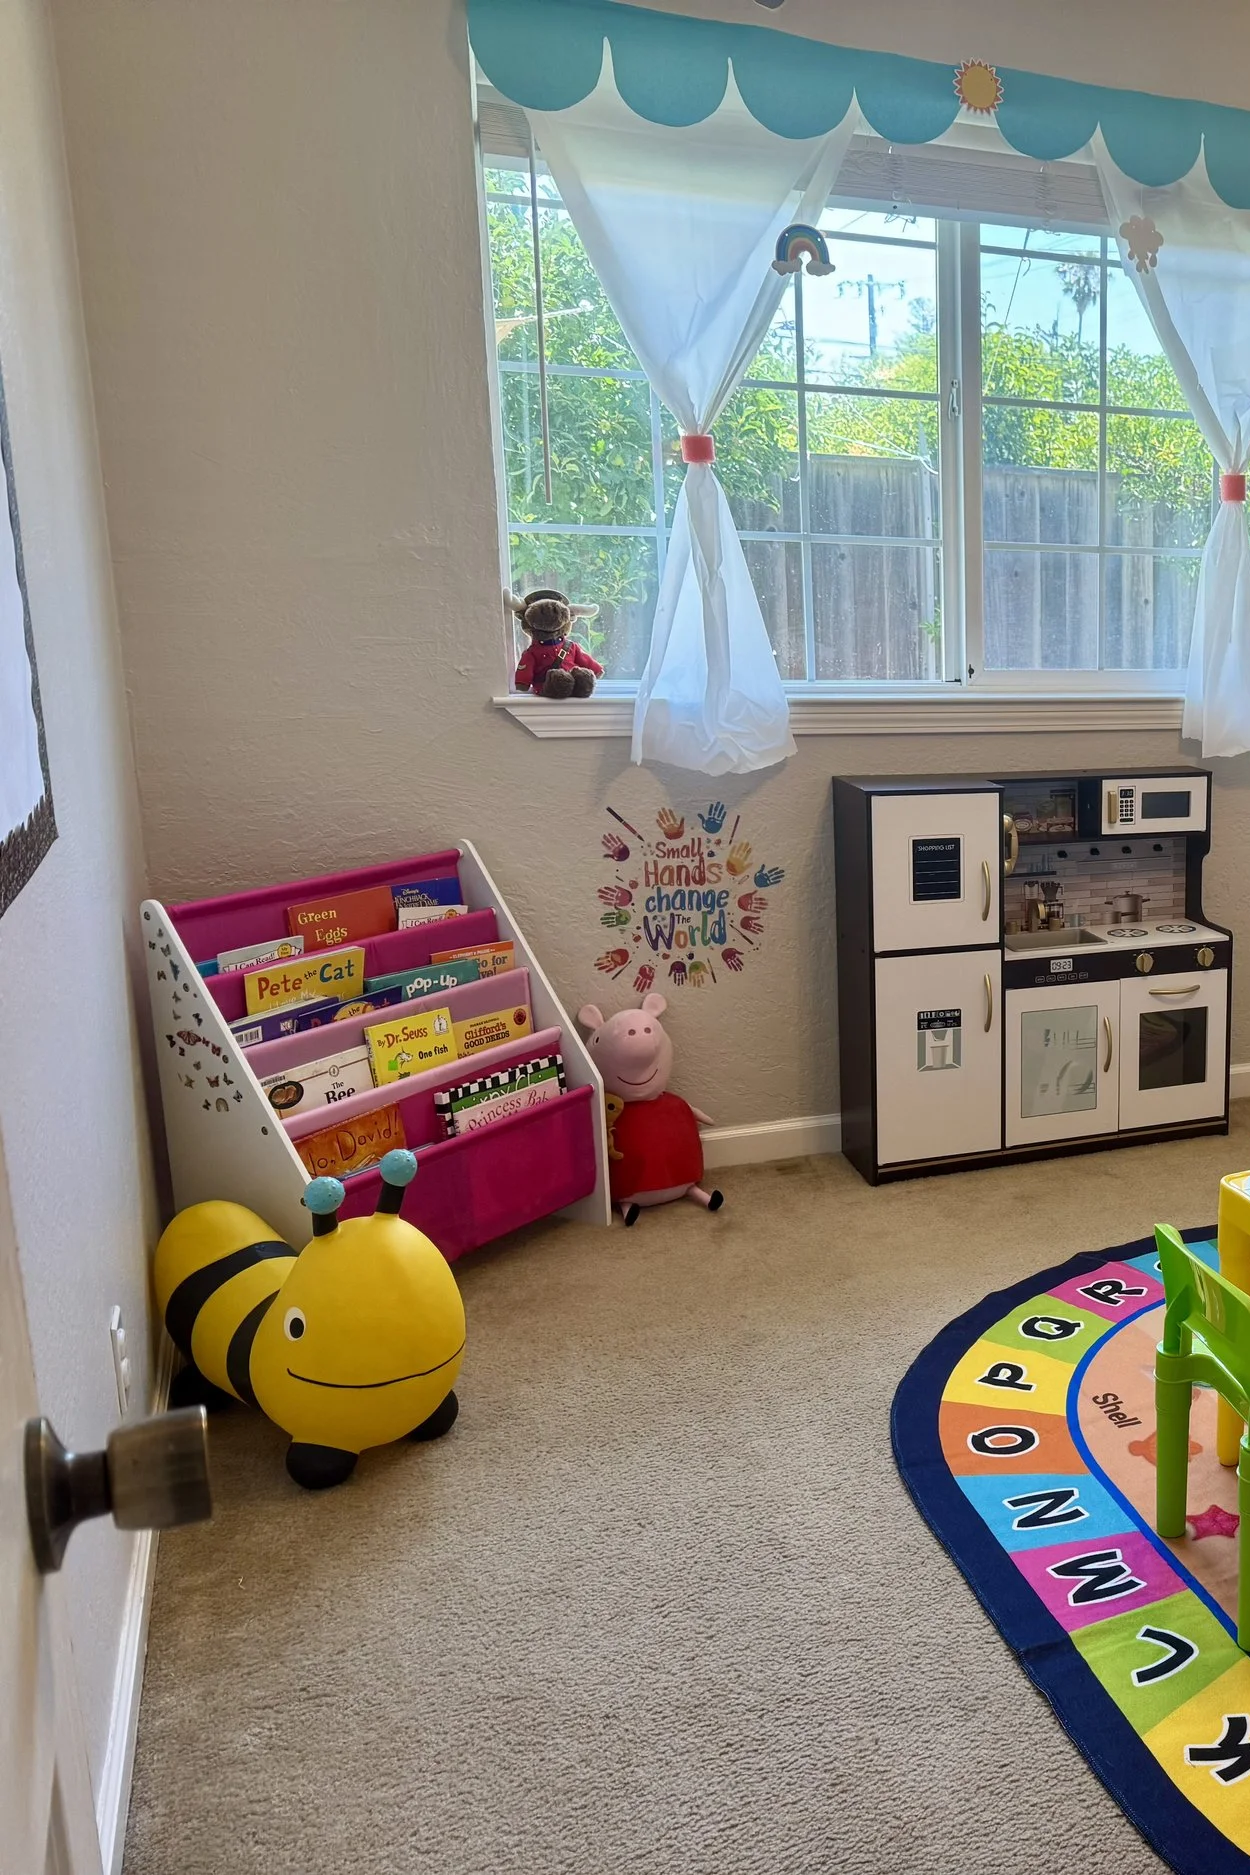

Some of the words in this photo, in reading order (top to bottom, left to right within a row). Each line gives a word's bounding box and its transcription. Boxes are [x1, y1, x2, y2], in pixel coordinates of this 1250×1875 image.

[655, 837, 704, 859] Small
[644, 857, 723, 887] Hands
[644, 886, 730, 915] change
[297, 908, 337, 926] Green
[643, 909, 727, 951] World
[675, 914, 691, 924] The
[315, 926, 348, 946] Eggs
[239, 961, 255, 970] Can
[256, 952, 276, 966] Read!
[257, 974, 303, 1000] Pete
[304, 968, 317, 980] the
[319, 959, 355, 983] Cat
[348, 1005, 361, 1017] the
[377, 1039, 386, 1048] By
[384, 1033, 402, 1049] Dr.
[401, 1026, 429, 1042] Seuss
[464, 1021, 507, 1041] Clifford's
[464, 1037, 485, 1050] GOOD
[485, 1030, 510, 1044] DEEDS
[418, 1049, 433, 1060] One
[433, 1044, 449, 1055] fish
[323, 1087, 356, 1104] Bee
[331, 1080, 344, 1090] The
[467, 1097, 523, 1131] Princess
[336, 1110, 399, 1162] David!
[1078, 1278, 1149, 1306] R
[1020, 1315, 1085, 1342] Q
[976, 1360, 1036, 1391] P
[1091, 1391, 1142, 1431] Shell
[966, 1424, 1041, 1458] O
[1004, 1486, 1091, 1531] N
[1046, 1549, 1147, 1606] M
[1131, 1625, 1199, 1688] L
